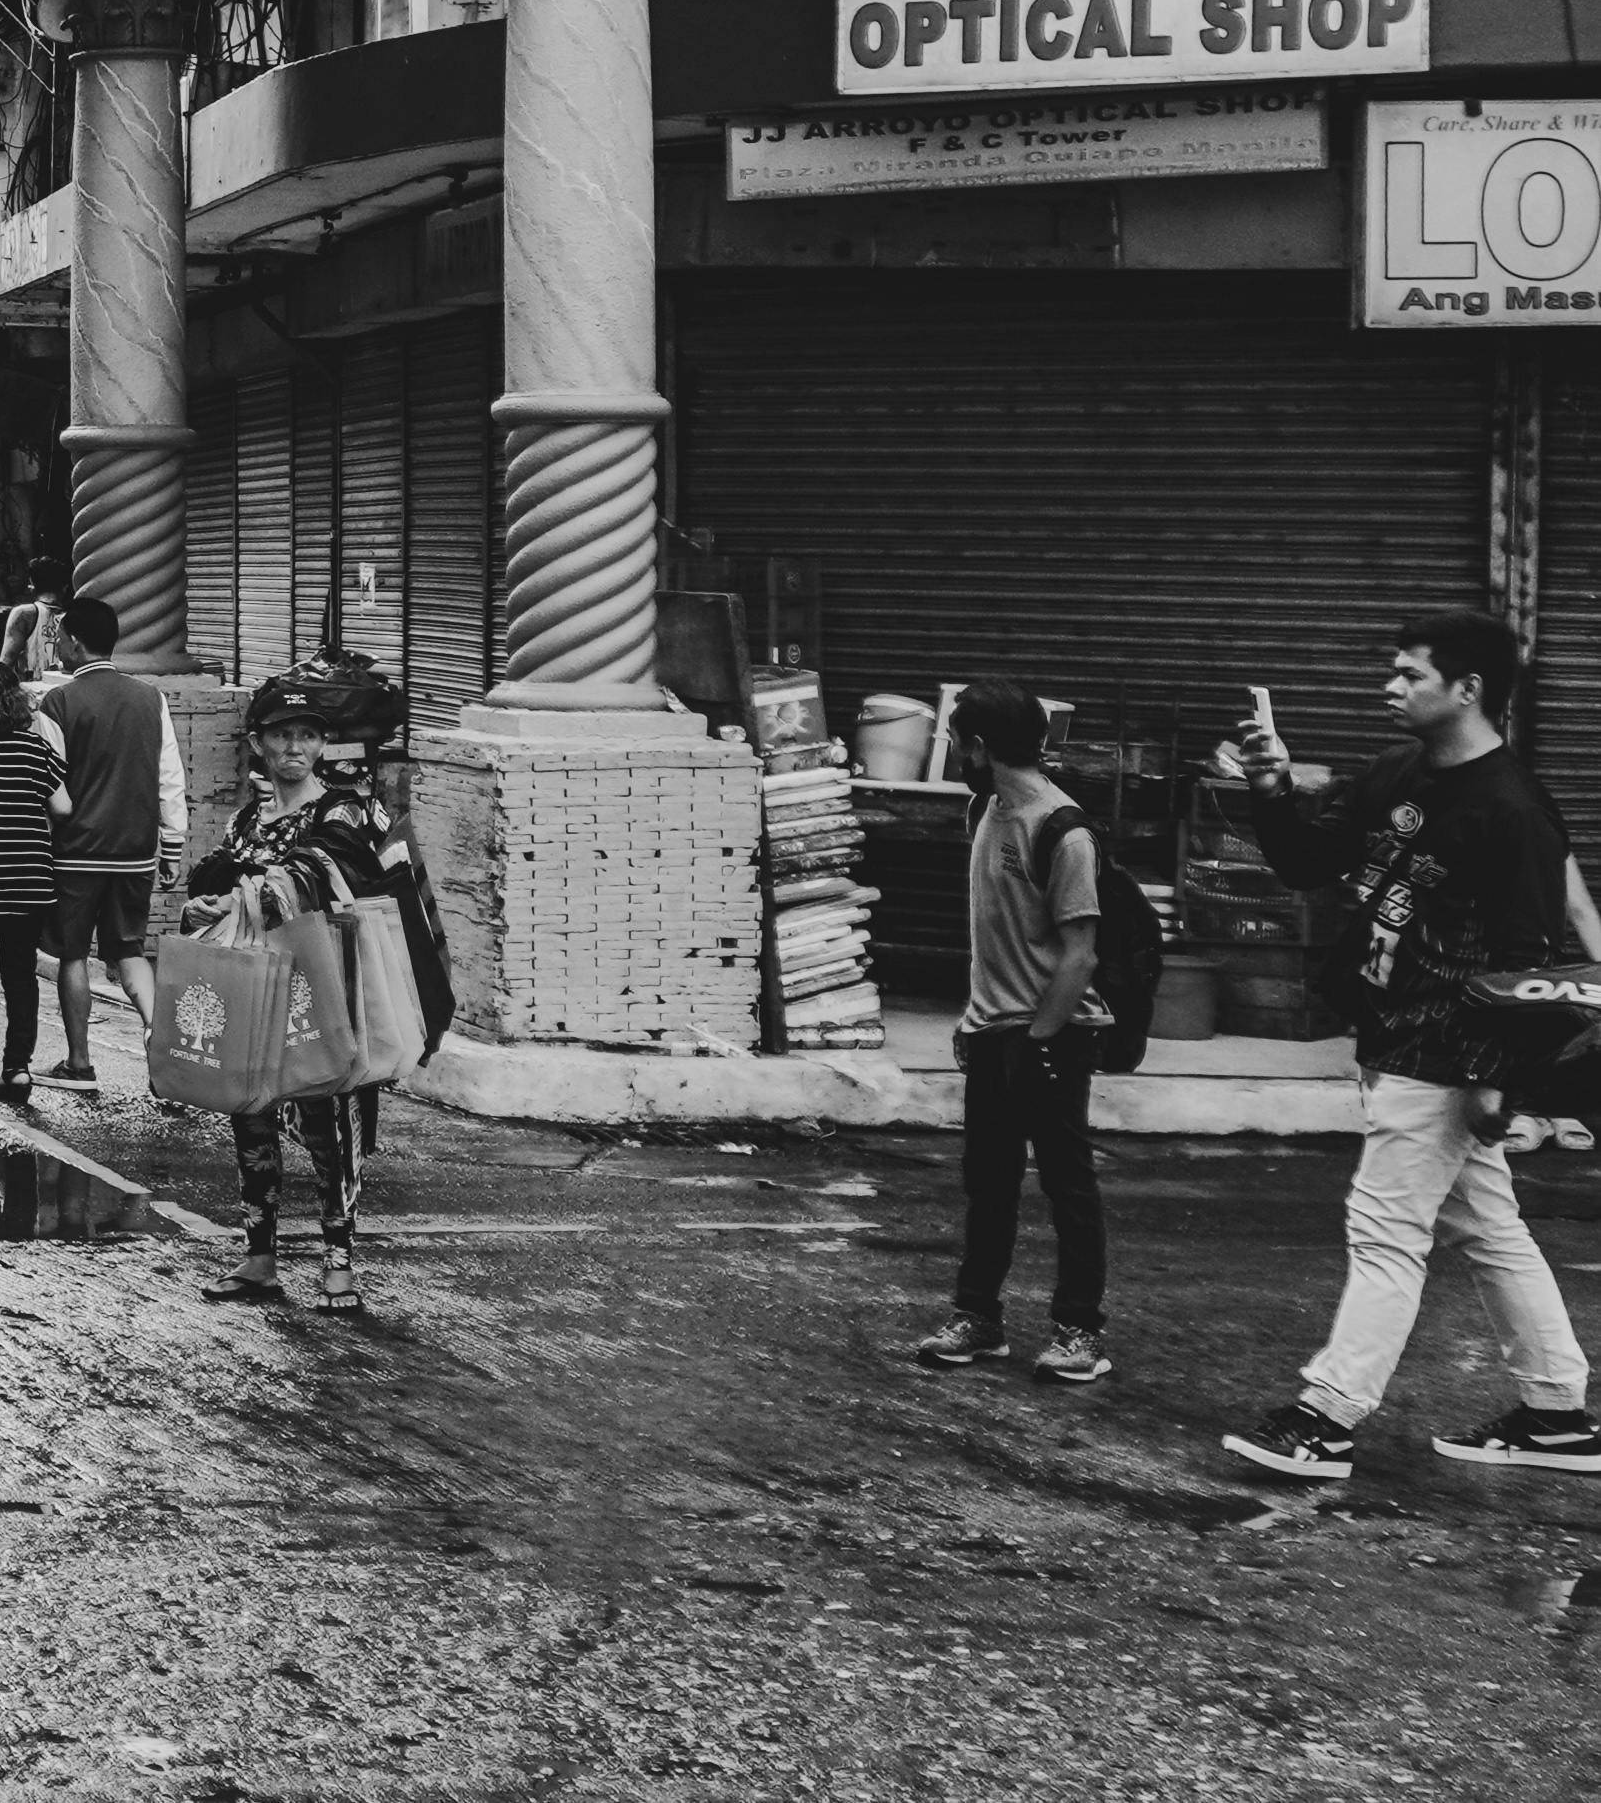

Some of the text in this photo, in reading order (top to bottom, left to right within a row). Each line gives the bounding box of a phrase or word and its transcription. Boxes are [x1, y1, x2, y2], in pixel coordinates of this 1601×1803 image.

[741, 125, 787, 144] JJ
[802, 114, 972, 141] ARROYO
[989, 101, 1178, 129] OPTICAL
[1422, 114, 1601, 133] Care, Share & Wi
[908, 127, 1127, 154] F & C Tower
[852, 152, 1008, 174] Miranda
[1023, 145, 1164, 165] Quiapo
[1398, 286, 1601, 316] Ang Mas
[169, 1047, 223, 1070] FORTUNE TREE
